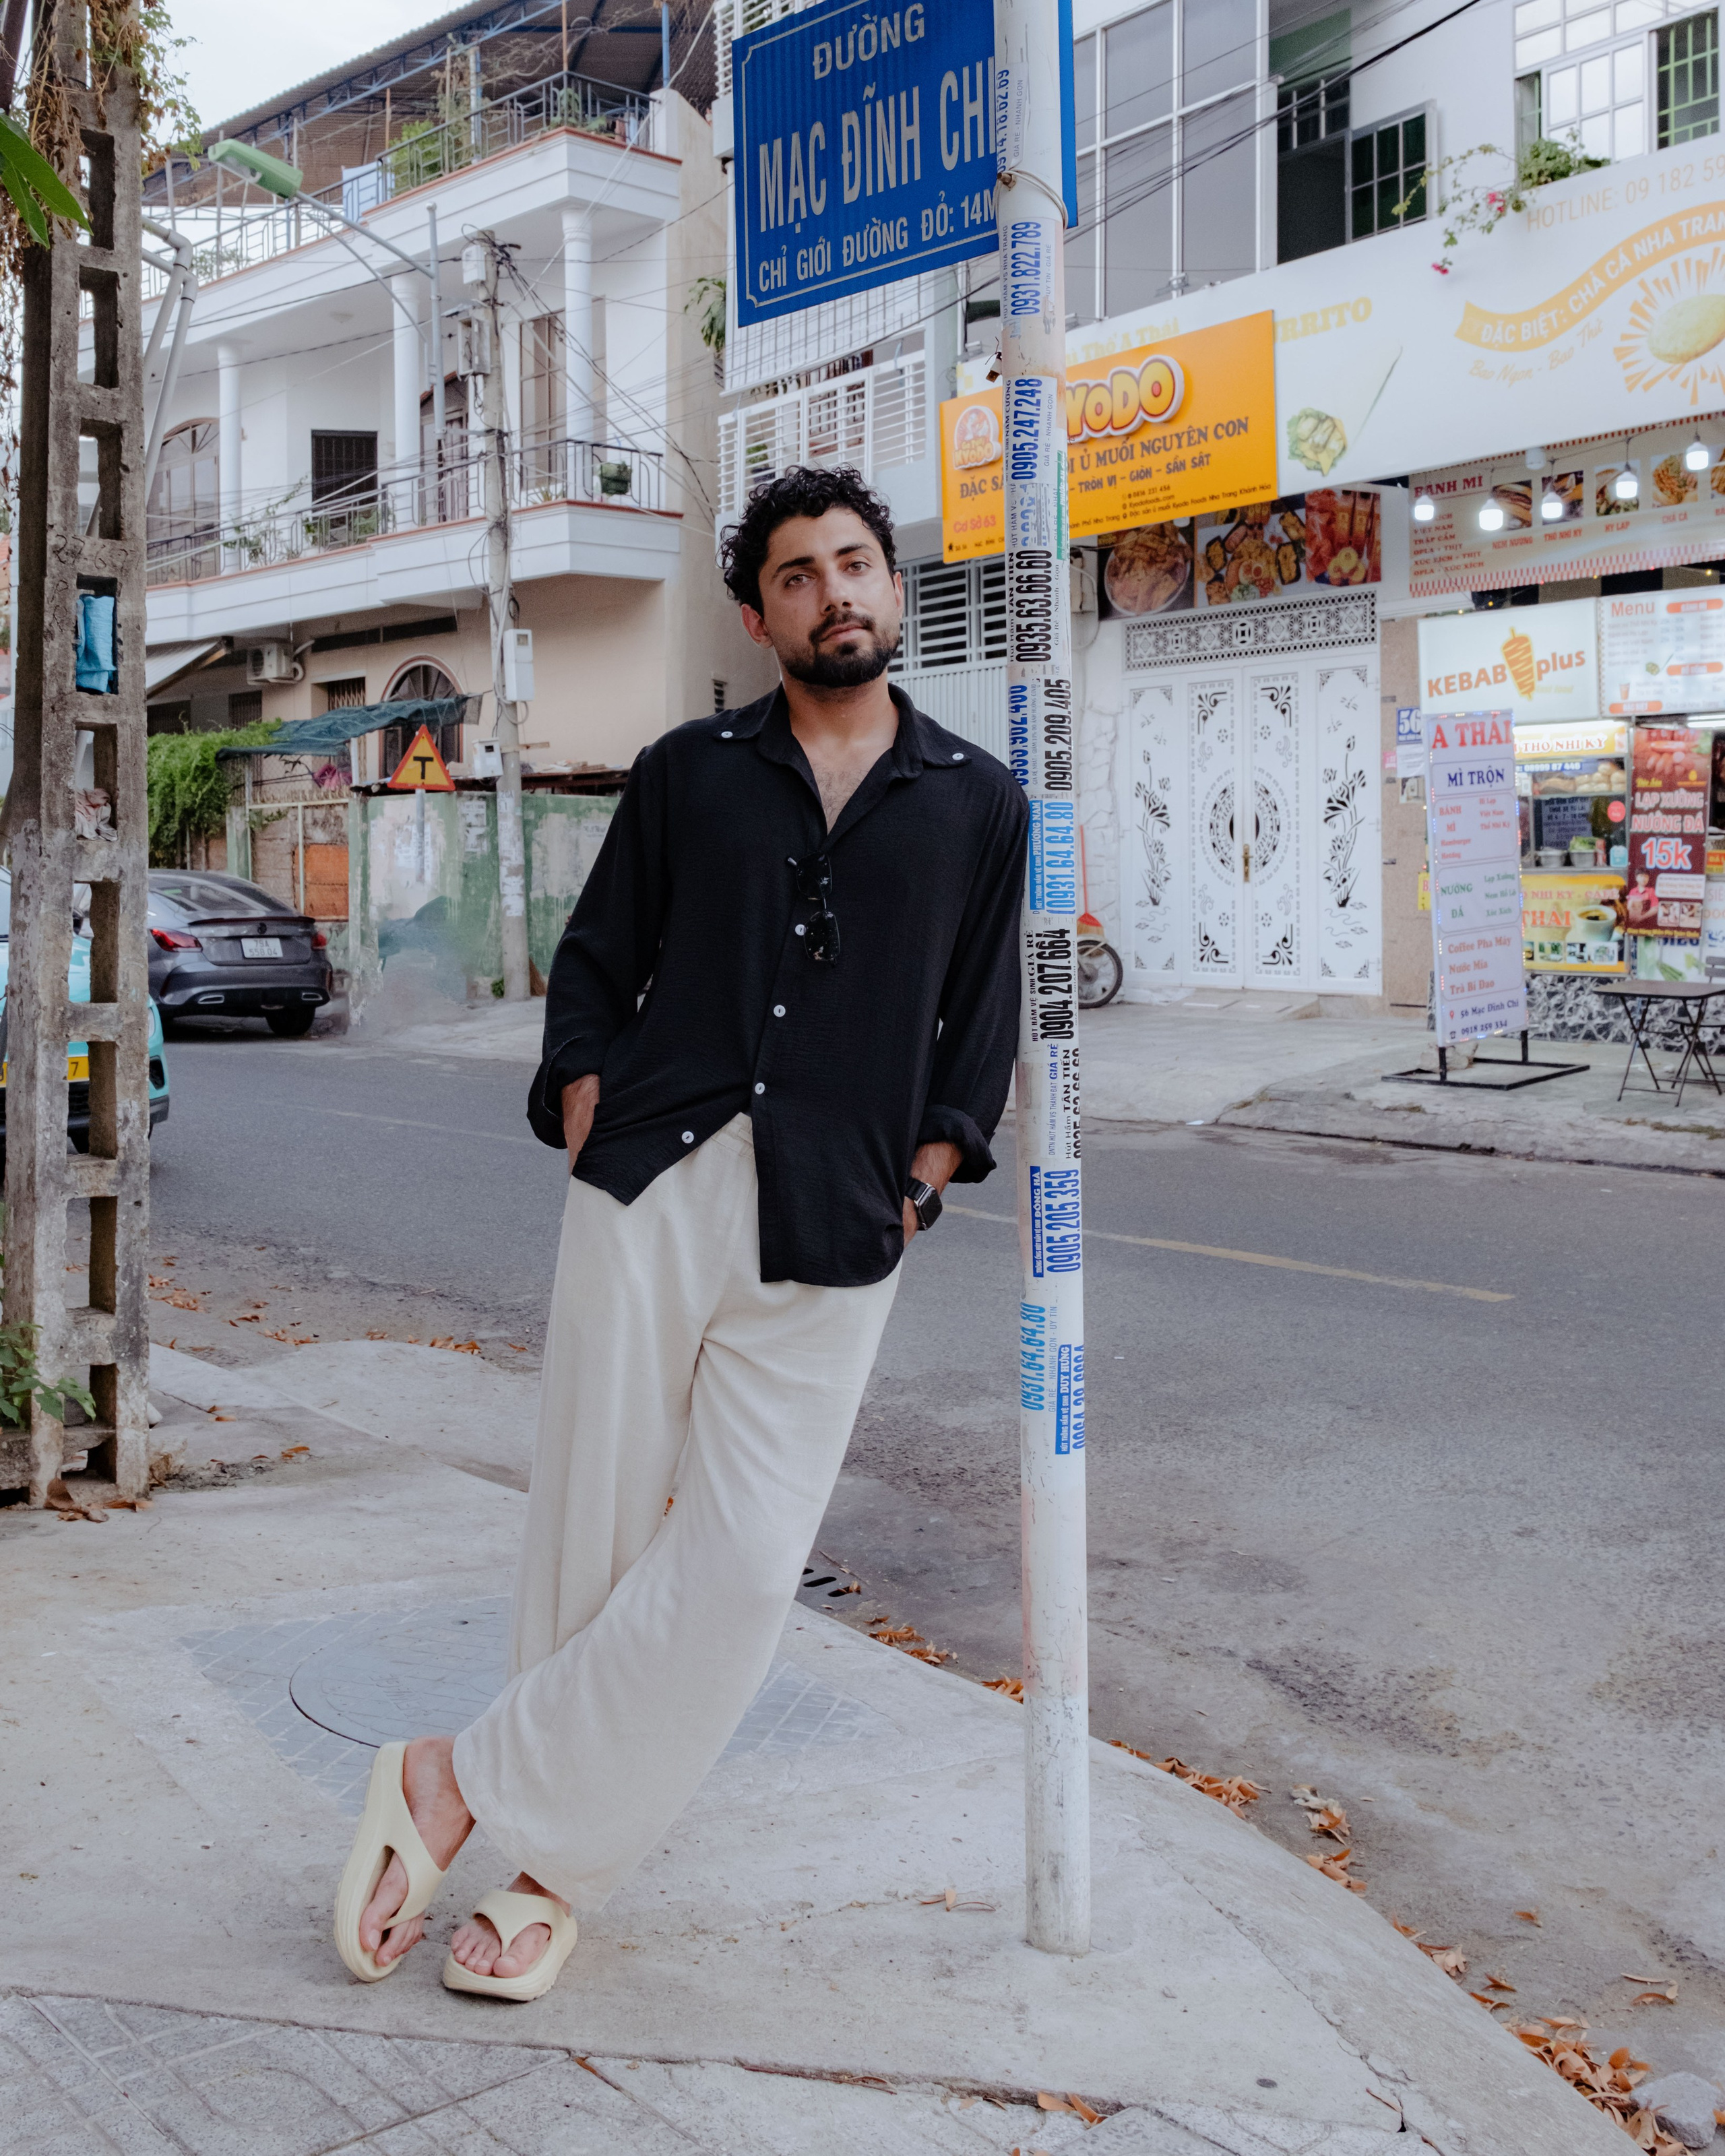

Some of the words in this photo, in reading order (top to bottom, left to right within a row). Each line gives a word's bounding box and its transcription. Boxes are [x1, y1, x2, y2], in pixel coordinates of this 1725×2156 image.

[813, 3, 926, 80] ĐƯỜNG
[759, 121, 827, 234] MẠC
[842, 82, 921, 205] ĐĨNH
[940, 56, 996, 171] CHI
[1625, 177, 1649, 203] 09
[1658, 164, 1694, 194] 182
[759, 245, 787, 292] CHỈ
[796, 232, 831, 282] GIỚI
[842, 213, 909, 267] ĐƯỜNG
[921, 190, 954, 241] ĐỎ:
[1011, 222, 1042, 315] 0931.822.789
[1480, 318, 1516, 348] ĐẶC
[1568, 270, 1606, 314] CHẢ
[1604, 246, 1632, 280] CÁ
[1633, 226, 1674, 261] NHA
[1274, 296, 1373, 343] RRITO
[1067, 358, 1177, 438] YODO
[1011, 379, 1042, 480] 0905.247.248
[1080, 449, 1091, 470] Ủ
[1096, 437, 1135, 468] MUỐI
[1140, 425, 1208, 457] NGUYÊN
[1214, 417, 1249, 440] CON
[960, 475, 986, 501] ĐẶC
[1078, 476, 1104, 493] TRÒN
[1107, 474, 1117, 489] VỊ
[1015, 550, 1052, 662] 0935.63.66.60
[1611, 602, 1655, 617] Menu
[1427, 664, 1508, 698] KEBAB
[1536, 650, 1586, 681] plus
[1044, 679, 1073, 791] 0905.209.405
[1432, 724, 1449, 749] A
[1455, 715, 1512, 747] THÁI
[1448, 767, 1464, 787] MÌ
[1468, 765, 1505, 788] TRỘN
[1032, 802, 1040, 821] NAM
[1032, 823, 1042, 856] PHƯƠNG
[1441, 838, 1471, 847] Hamburger
[1641, 837, 1692, 870] 15k
[1024, 930, 1034, 948] RẺ
[1448, 942, 1475, 954] Coffee
[1477, 938, 1493, 950] Pha
[1495, 935, 1511, 947] Máy
[1025, 952, 1036, 976] GIÁ
[1449, 961, 1471, 974] Nước
[1036, 929, 1074, 1039] 0904.207.664
[1450, 982, 1465, 995] Trà
[1460, 1010, 1469, 1018] 56
[1471, 1006, 1484, 1017] Mạc
[1462, 1025, 1478, 1035] 0918
[1047, 1044, 1059, 1057] RẺ
[1060, 1049, 1071, 1079] TIẾN
[1047, 1062, 1058, 1080] GIÁ
[1061, 1084, 1071, 1112] TÂN
[1049, 1110, 1057, 1118] VS
[1033, 1188, 1041, 1217] ĐÔNG
[1044, 1169, 1081, 1273] 0905.205.359
[1049, 1319, 1057, 1329] UY
[1020, 1302, 1045, 1411] 0931.64.64.80
[1060, 1374, 1069, 1393] DUY
[1048, 1401, 1056, 1412] GIÁ
